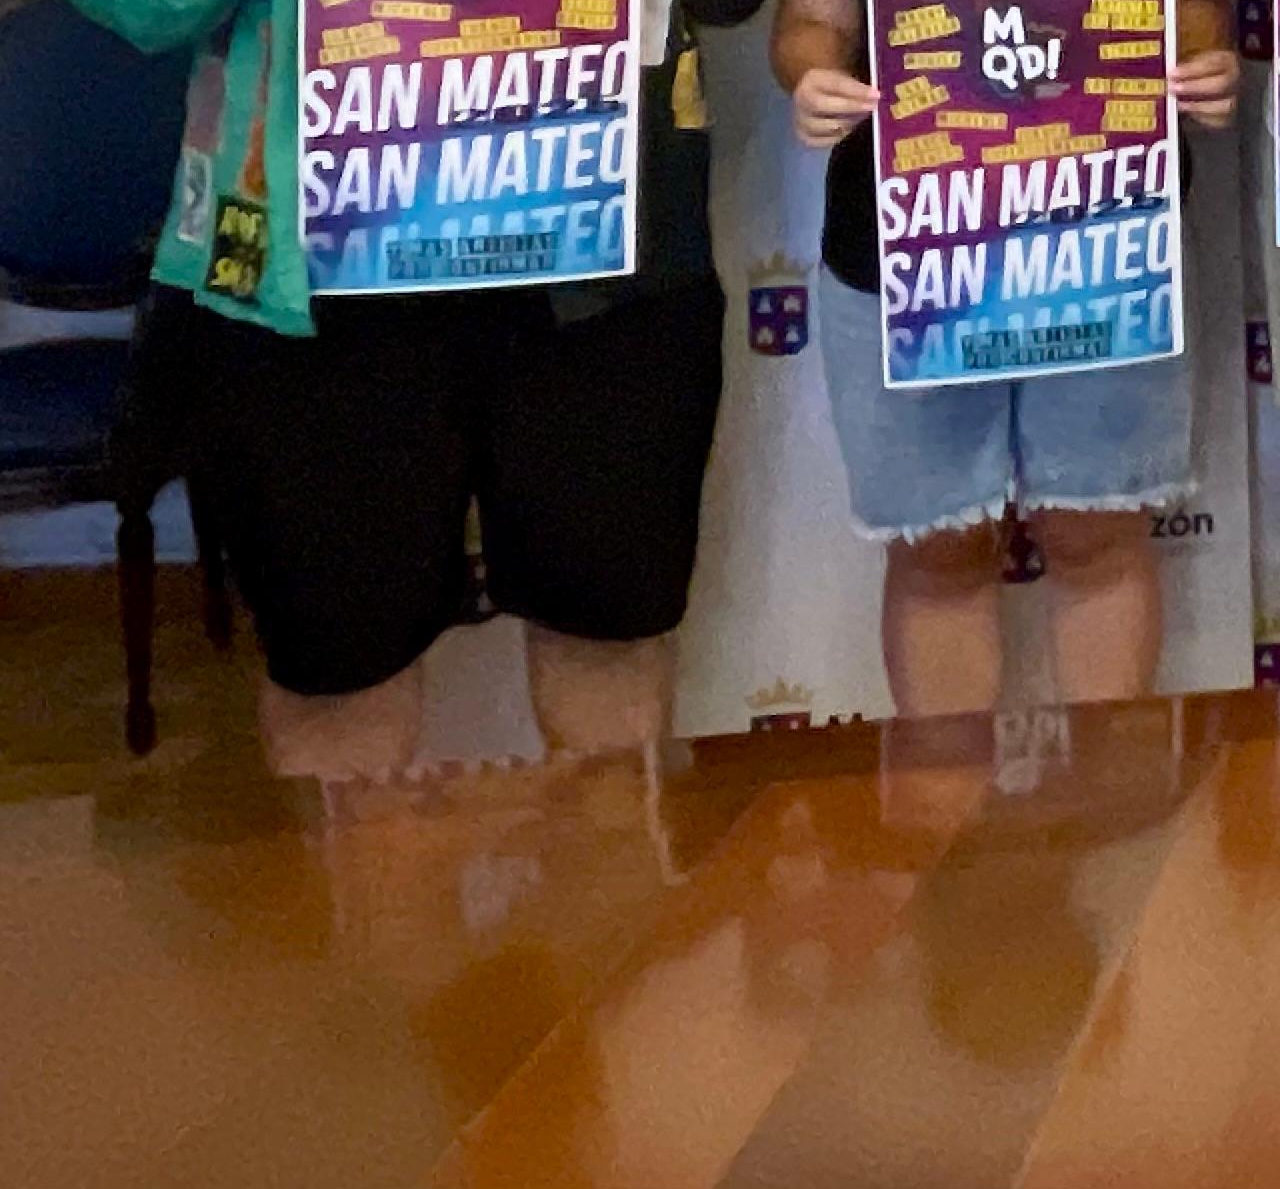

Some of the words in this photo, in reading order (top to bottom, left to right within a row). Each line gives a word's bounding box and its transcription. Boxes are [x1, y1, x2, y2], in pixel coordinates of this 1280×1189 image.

[982, 38, 1061, 90] QD!
[984, 6, 1025, 44] M
[304, 62, 422, 138] SAN
[437, 40, 627, 126] MATEO
[305, 143, 421, 217] SAN
[436, 117, 626, 205] MATEO
[881, 168, 984, 240] SAN
[999, 139, 1168, 228] MATEO
[884, 243, 986, 315] SAN
[1002, 212, 1170, 300] MATEO
